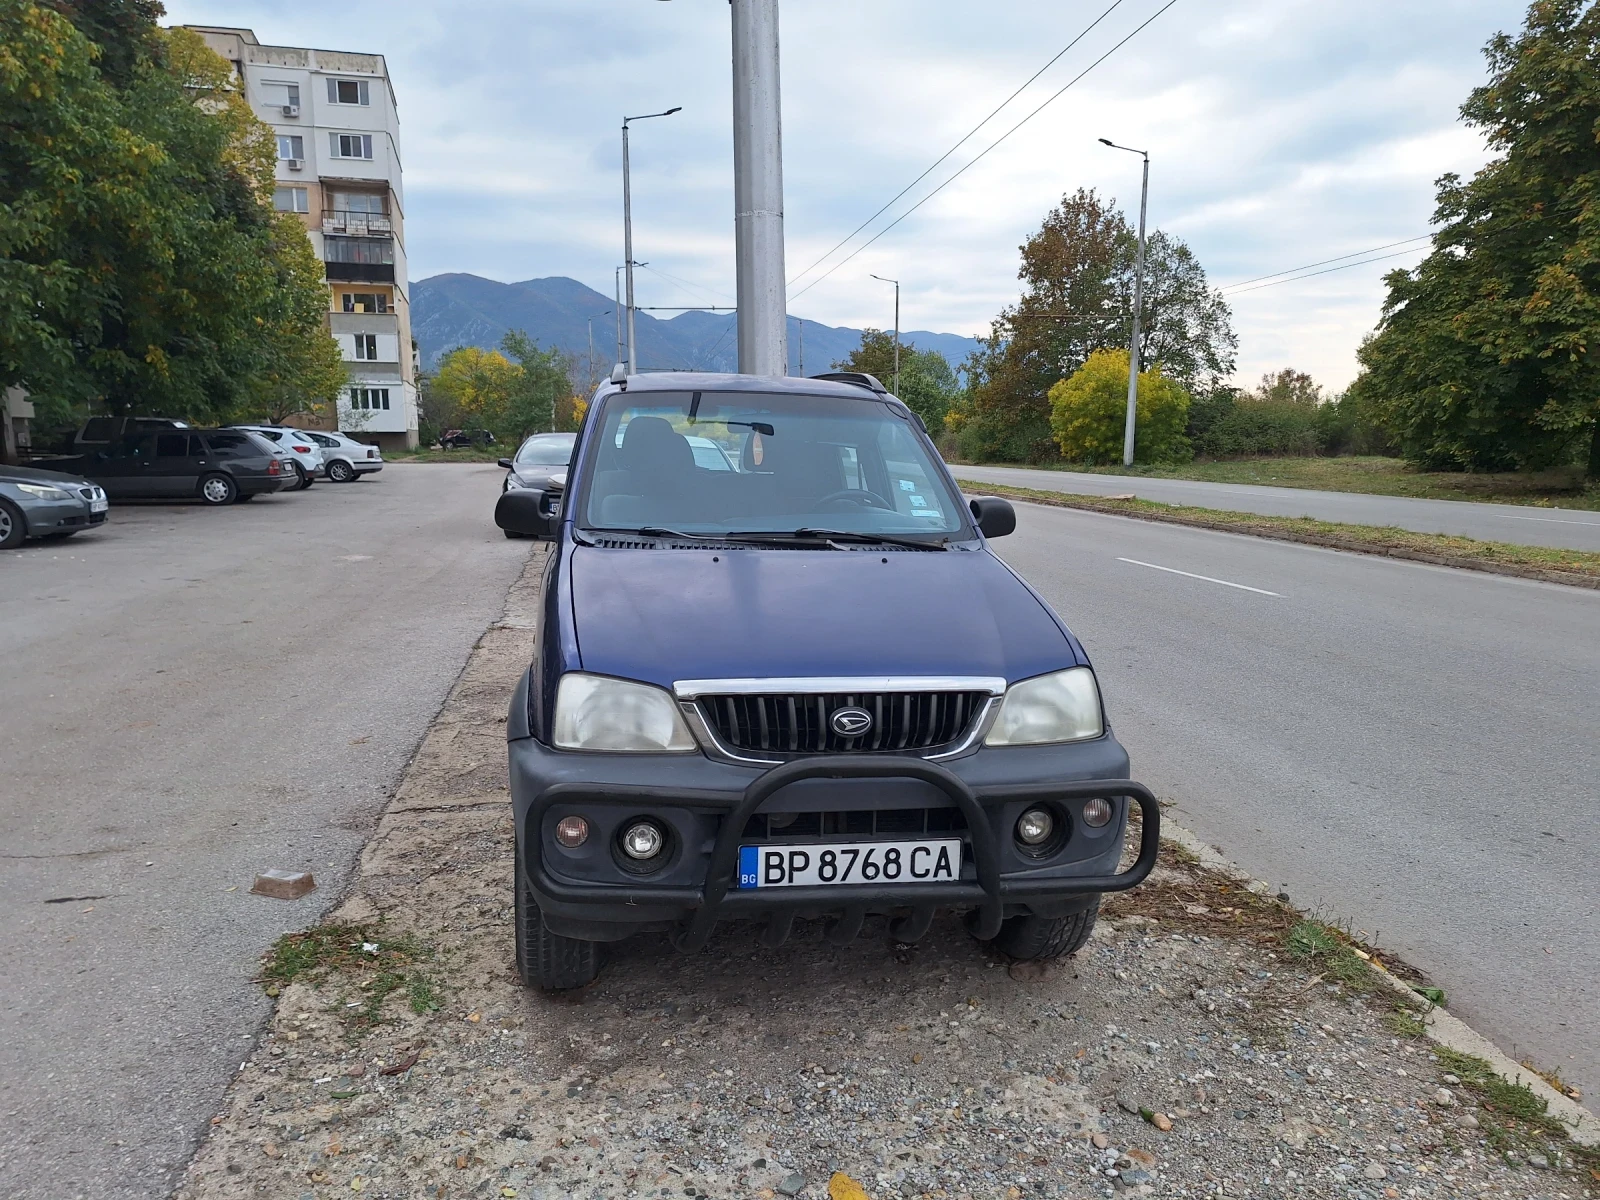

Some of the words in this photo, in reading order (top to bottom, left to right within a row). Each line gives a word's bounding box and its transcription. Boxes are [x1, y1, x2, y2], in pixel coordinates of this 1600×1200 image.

[764, 850, 810, 884] BP
[818, 847, 902, 882] 8768
[910, 845, 953, 879] CA
[741, 873, 757, 884] BG
